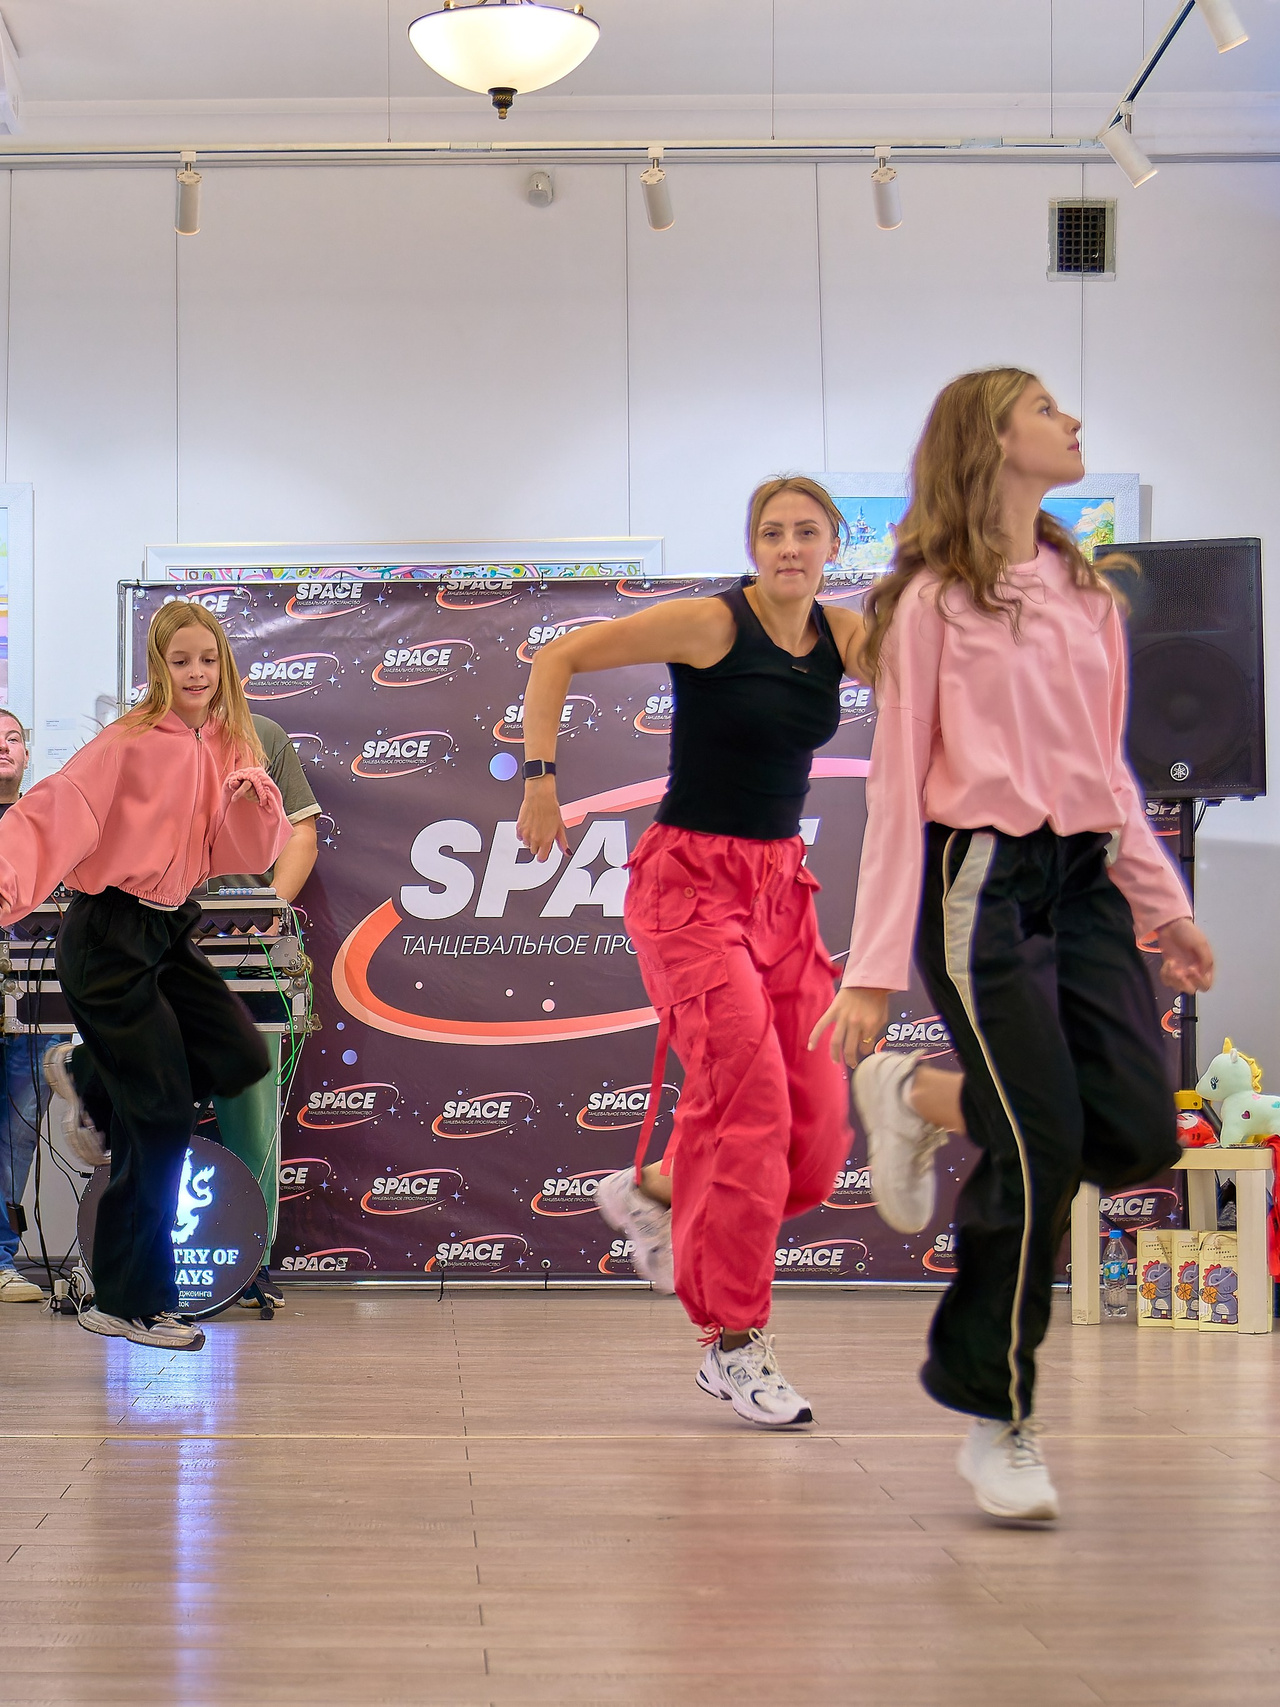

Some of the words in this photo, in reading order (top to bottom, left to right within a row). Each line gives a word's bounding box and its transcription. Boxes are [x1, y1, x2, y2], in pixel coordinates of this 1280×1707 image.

[296, 583, 363, 600] SPACE
[446, 579, 513, 591] SPACE
[383, 649, 452, 667] SPACE
[248, 662, 317, 679] SPACE
[362, 740, 431, 758] SPACE
[400, 819, 630, 920] SPA
[402, 934, 588, 958] ТАНЦЕВАЛЬНОЕ
[308, 1092, 376, 1109] SPACE
[442, 1101, 512, 1118] SPACE
[372, 1178, 440, 1195] SPACE
[542, 1179, 600, 1196] SPAC
[1099, 1198, 1156, 1216] PACE
[213, 1249, 239, 1265] OF
[435, 1243, 504, 1261] SPACE
[774, 1249, 844, 1266] SPACE
